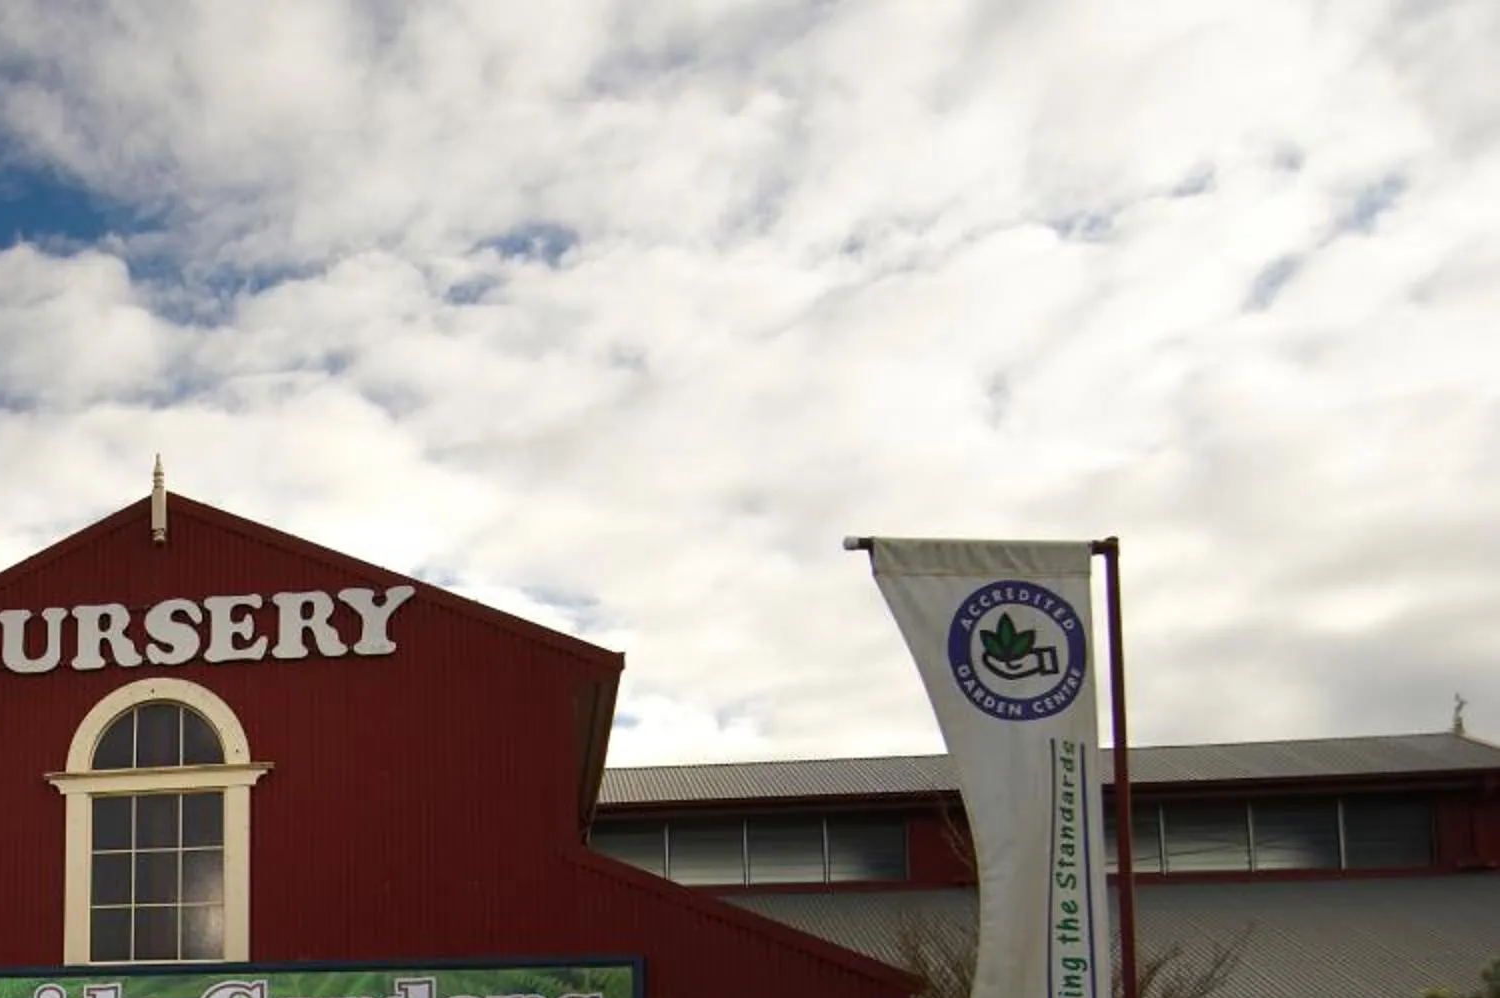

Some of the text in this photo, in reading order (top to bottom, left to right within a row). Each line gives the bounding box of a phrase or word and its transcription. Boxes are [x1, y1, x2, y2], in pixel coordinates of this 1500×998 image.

[960, 587, 1075, 631] ACCREDITED
[958, 664, 1081, 716] GARDEN CENTRE
[1056, 740, 1080, 890] Standards
[1056, 900, 1080, 943] the
